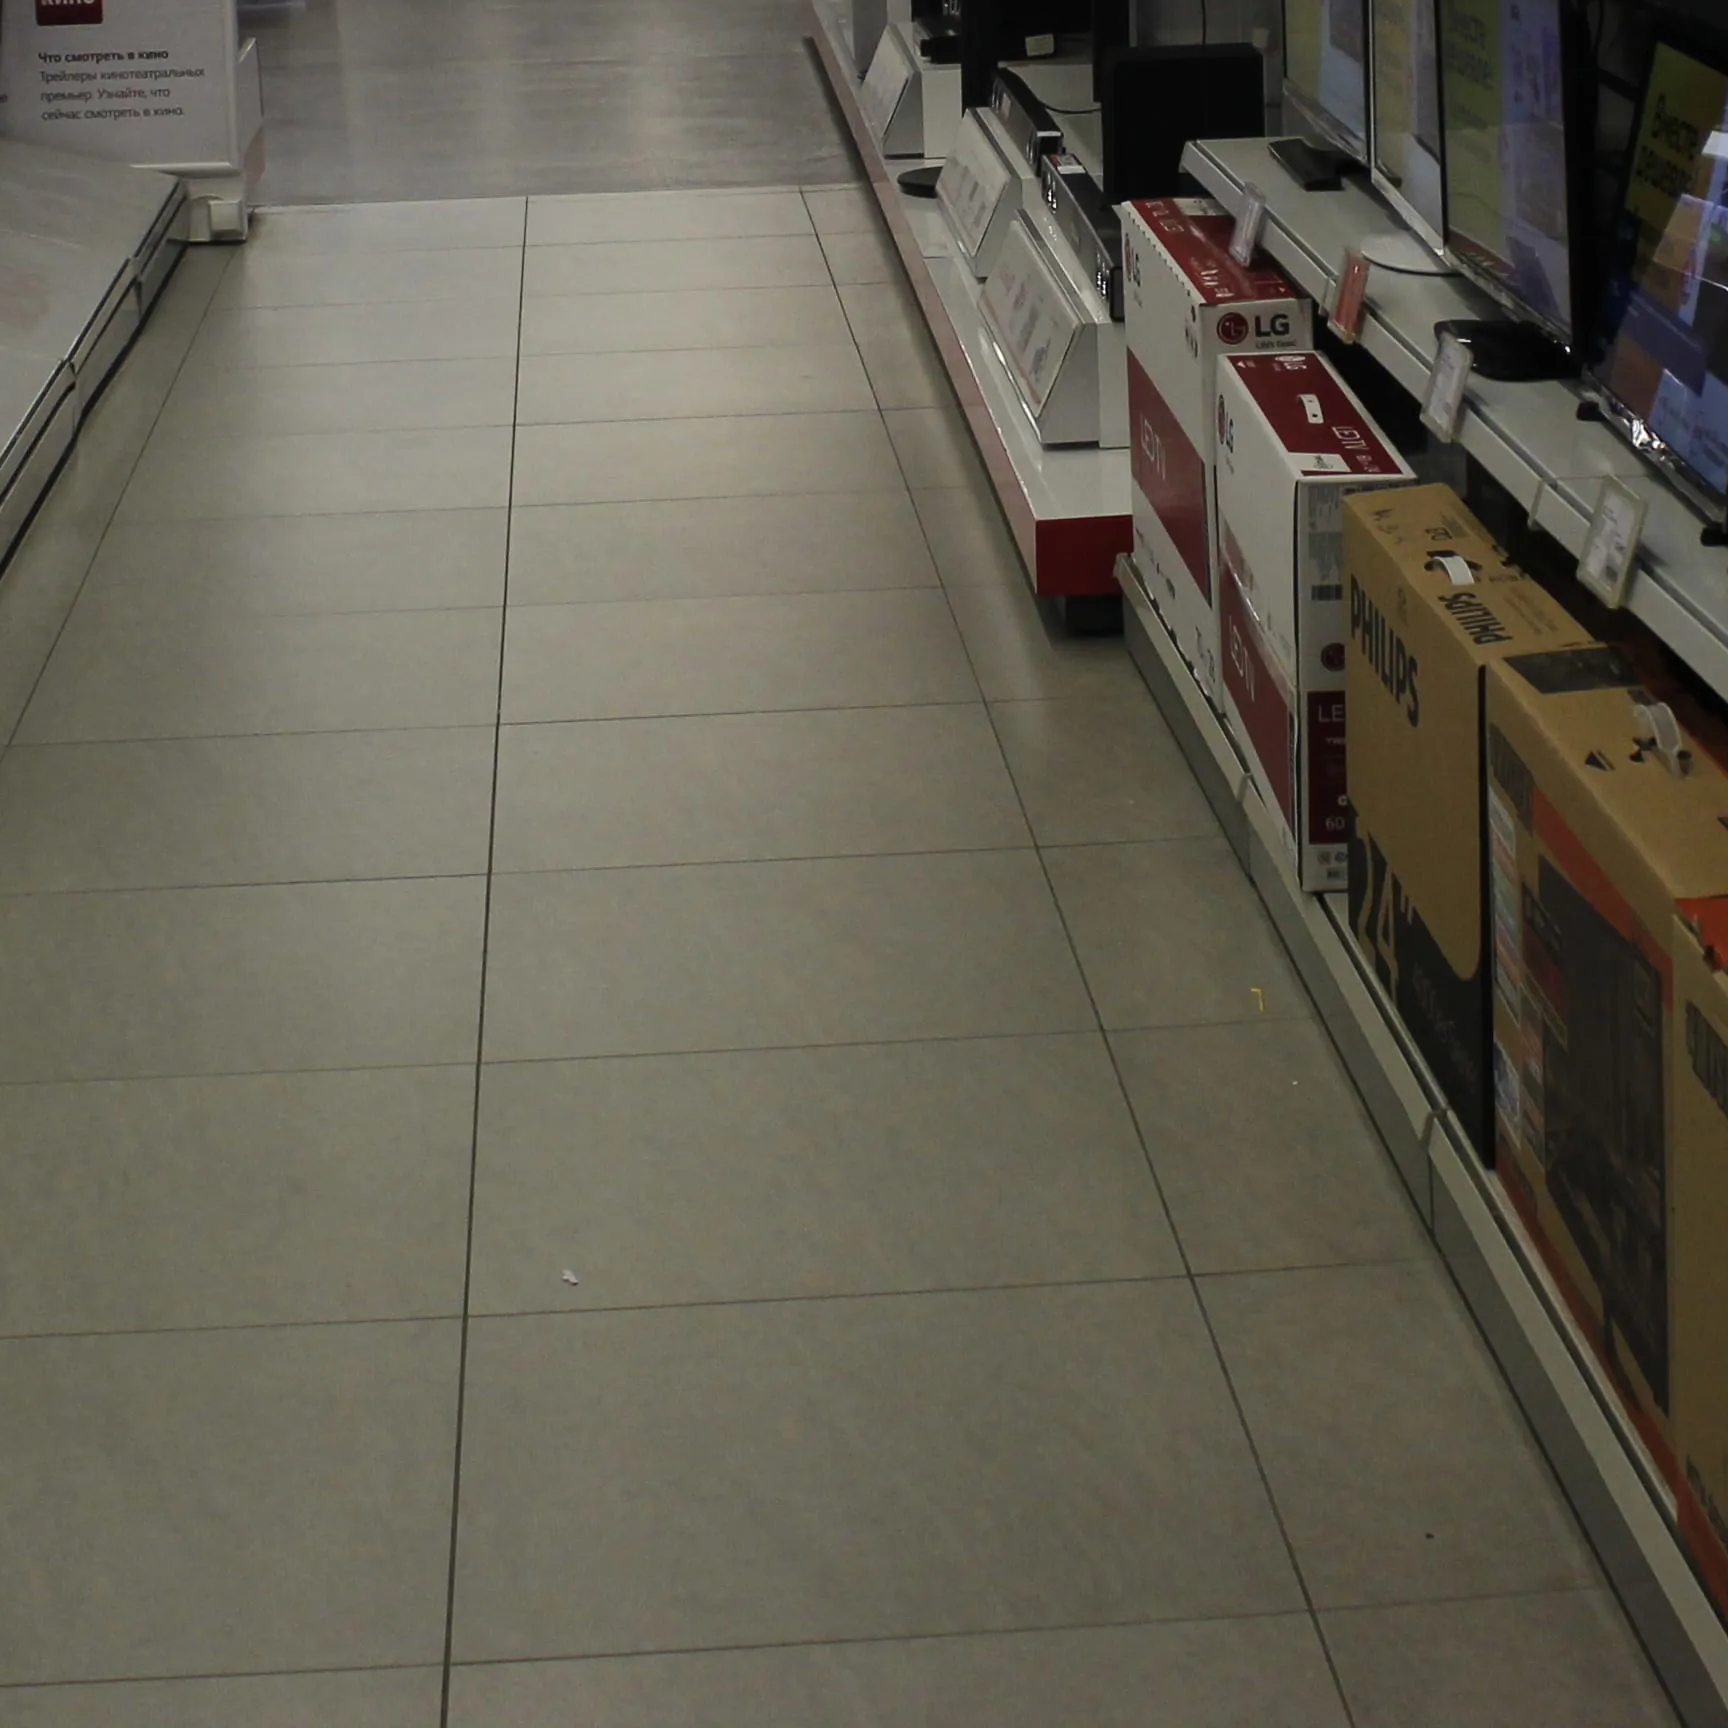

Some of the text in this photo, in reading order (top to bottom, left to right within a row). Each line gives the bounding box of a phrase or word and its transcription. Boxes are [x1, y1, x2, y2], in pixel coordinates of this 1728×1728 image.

[38, 52, 62, 64] Что
[65, 52, 124, 64] смотреть
[138, 50, 169, 60] кино
[40, 67, 206, 86] Трейлеры кинотеатральных
[150, 88, 171, 98] что
[41, 109, 83, 121] сейчас
[84, 108, 141, 120] смотреть
[1255, 313, 1290, 337] LG
[1441, 591, 1512, 646] PHILIPS
[1348, 572, 1420, 729] PHILIPS
[1317, 703, 1346, 724] LE
